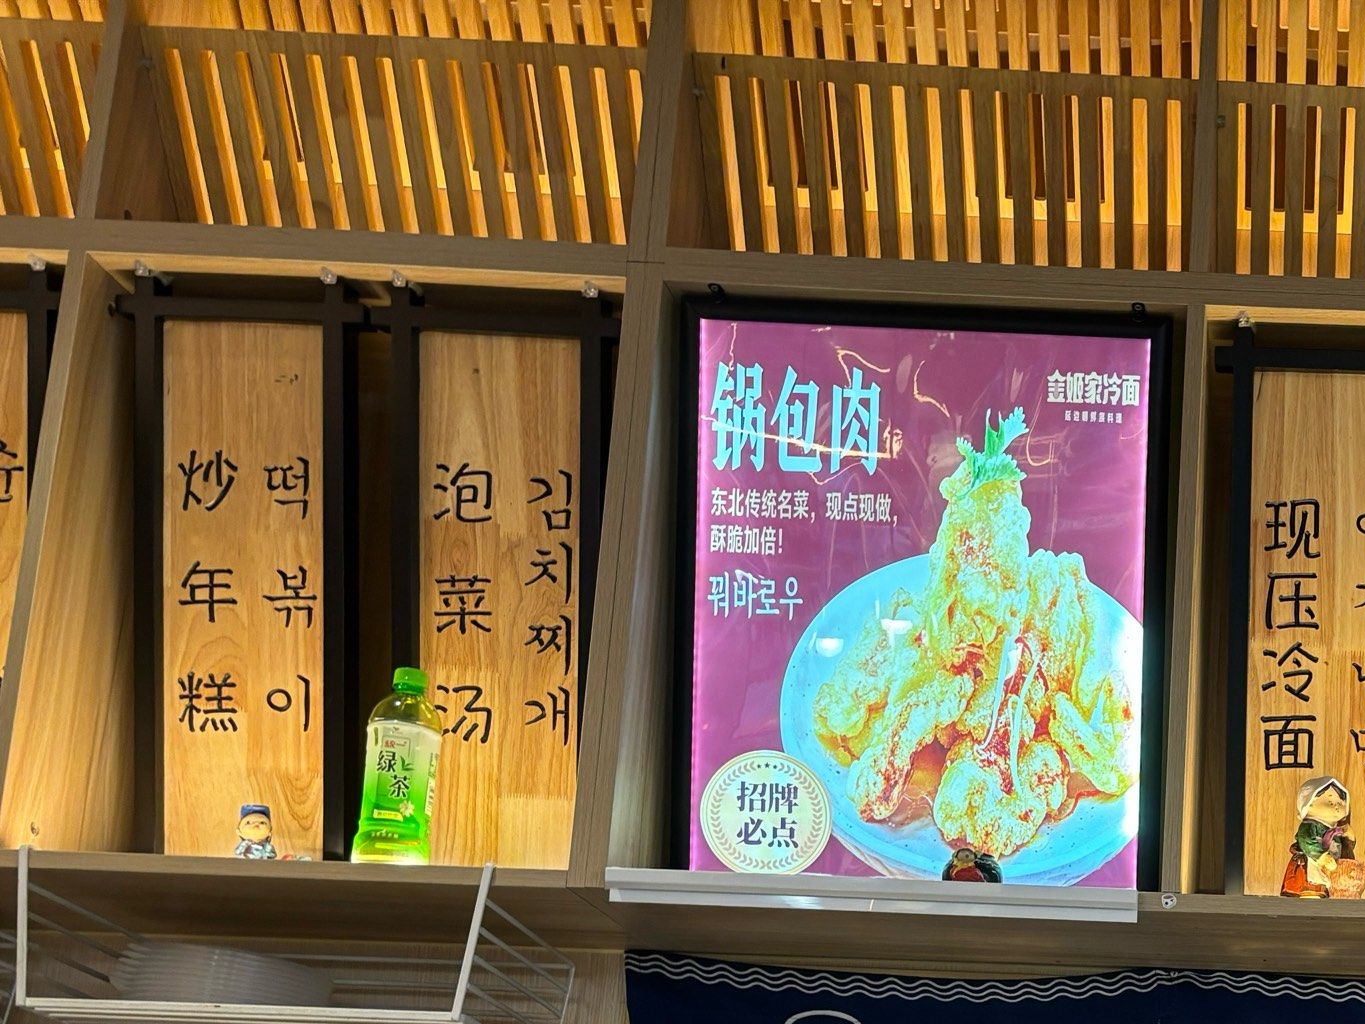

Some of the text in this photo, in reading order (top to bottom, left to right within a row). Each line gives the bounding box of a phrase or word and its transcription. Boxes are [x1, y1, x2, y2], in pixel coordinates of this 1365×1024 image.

[710, 361, 882, 477] 锅包肉
[1047, 369, 1141, 406] 金姬家冷面
[178, 450, 238, 732] 炒年糕
[263, 456, 318, 732] 떡볶이
[433, 463, 493, 744] 泡菜汤
[524, 470, 573, 746] 김치찌개
[1261, 499, 1321, 771] 现压冷面
[377, 750, 410, 798] 绿茶
[736, 816, 799, 848] 必点
[737, 781, 799, 814] 招牌
